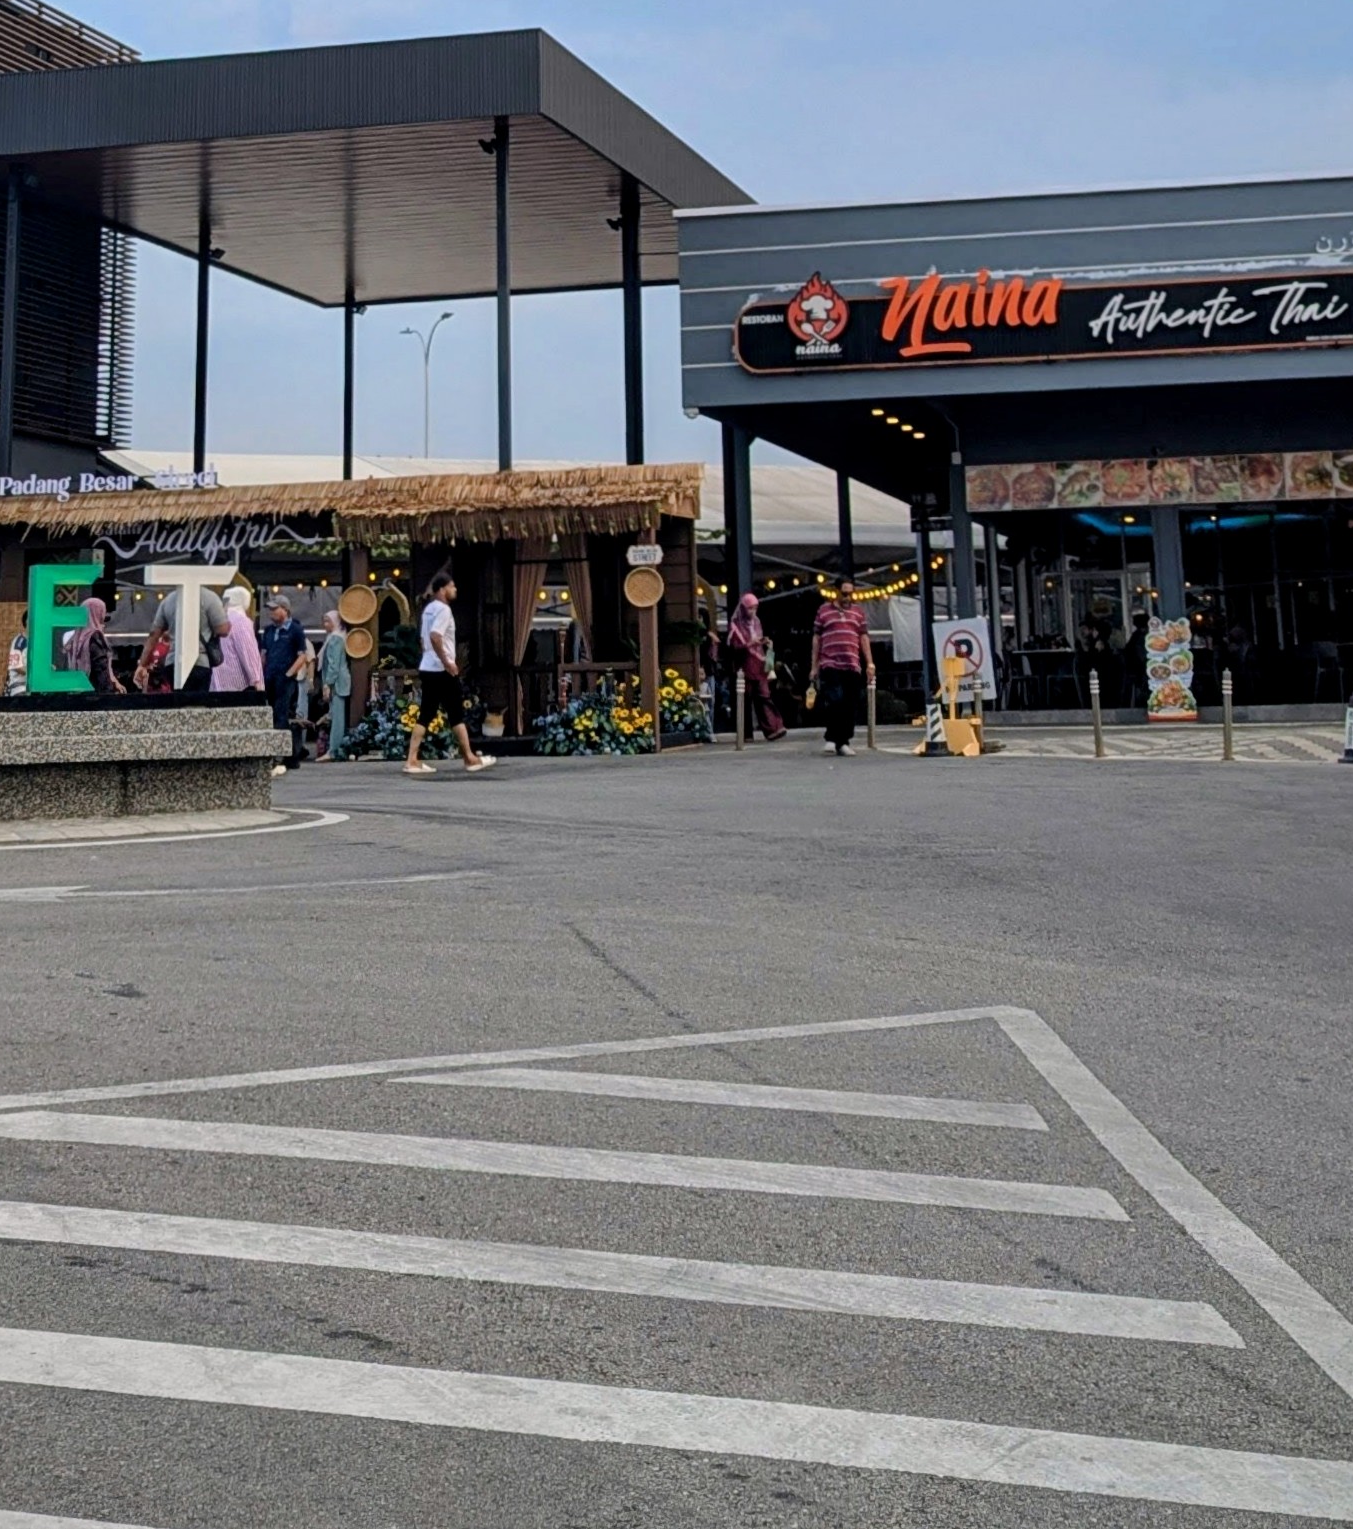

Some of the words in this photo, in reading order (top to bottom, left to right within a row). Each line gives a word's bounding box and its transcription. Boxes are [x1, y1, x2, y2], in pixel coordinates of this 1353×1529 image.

[741, 314, 784, 325] RESTORAN
[879, 267, 1064, 358] Naina
[1089, 287, 1256, 344] Authentic
[1252, 281, 1348, 335] Thai
[794, 340, 843, 355] naina
[79, 472, 140, 494] Besar
[93, 519, 322, 566] Aidilfitri
